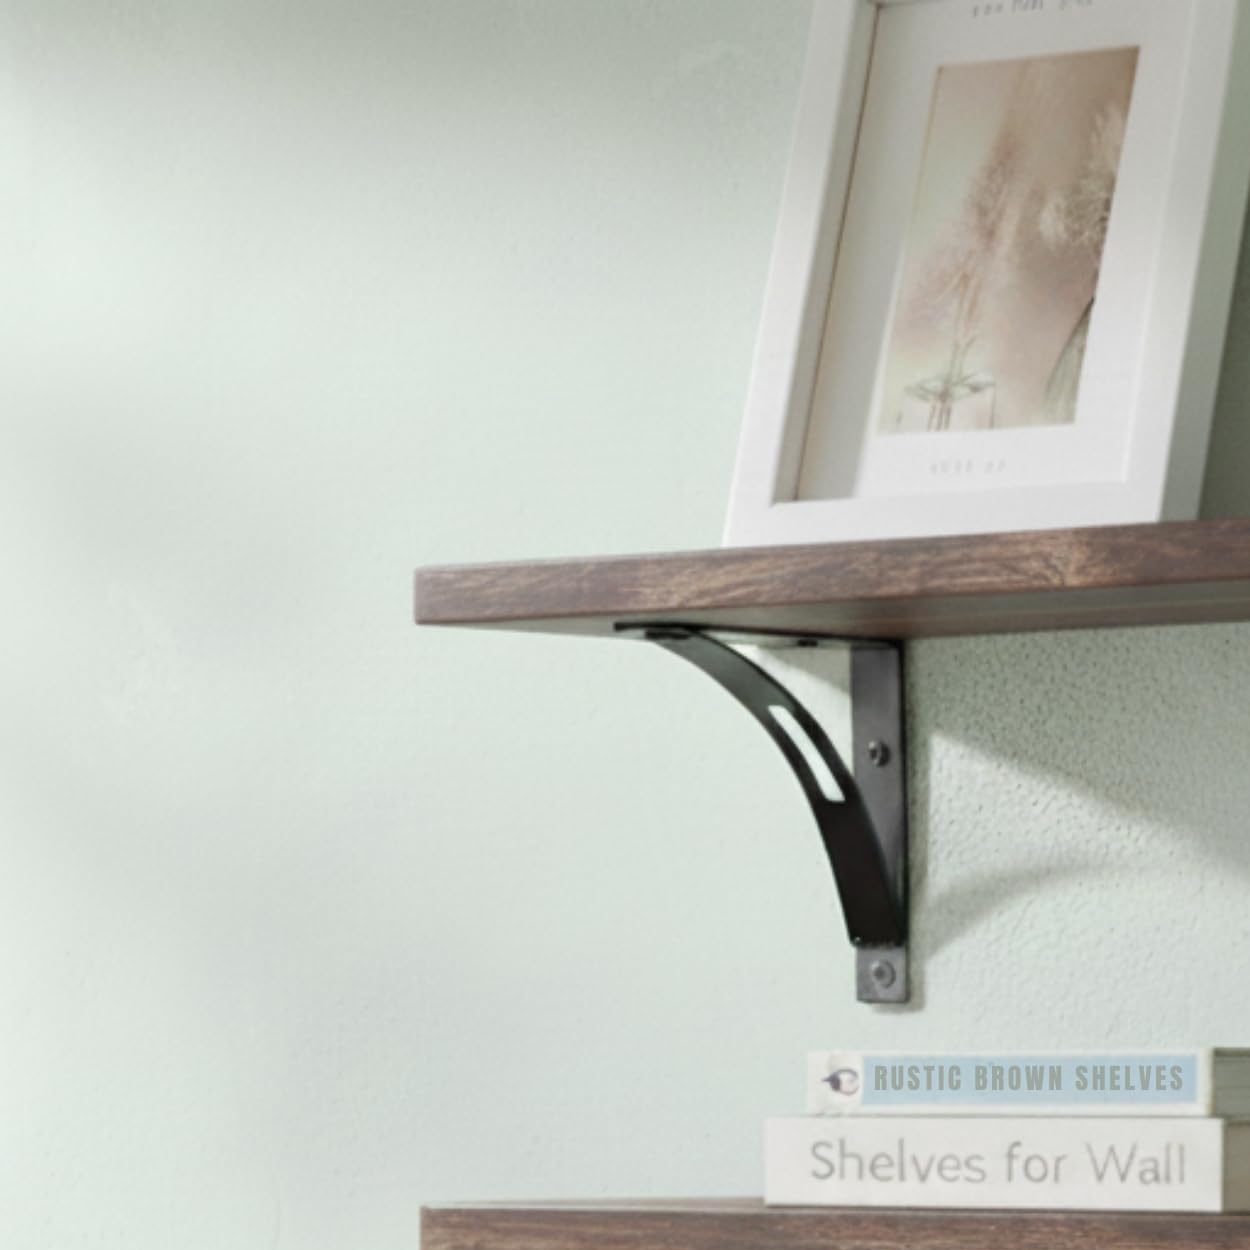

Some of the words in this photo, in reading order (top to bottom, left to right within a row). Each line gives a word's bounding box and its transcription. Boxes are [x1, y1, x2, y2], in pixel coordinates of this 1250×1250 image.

[873, 1065, 962, 1091] RUSTIC
[974, 1065, 1063, 1091] BROWN
[1075, 1065, 1184, 1091] SHELVES
[810, 1138, 987, 1183] Shelves
[1005, 1141, 1067, 1184] for
[1086, 1141, 1185, 1185] Wall
